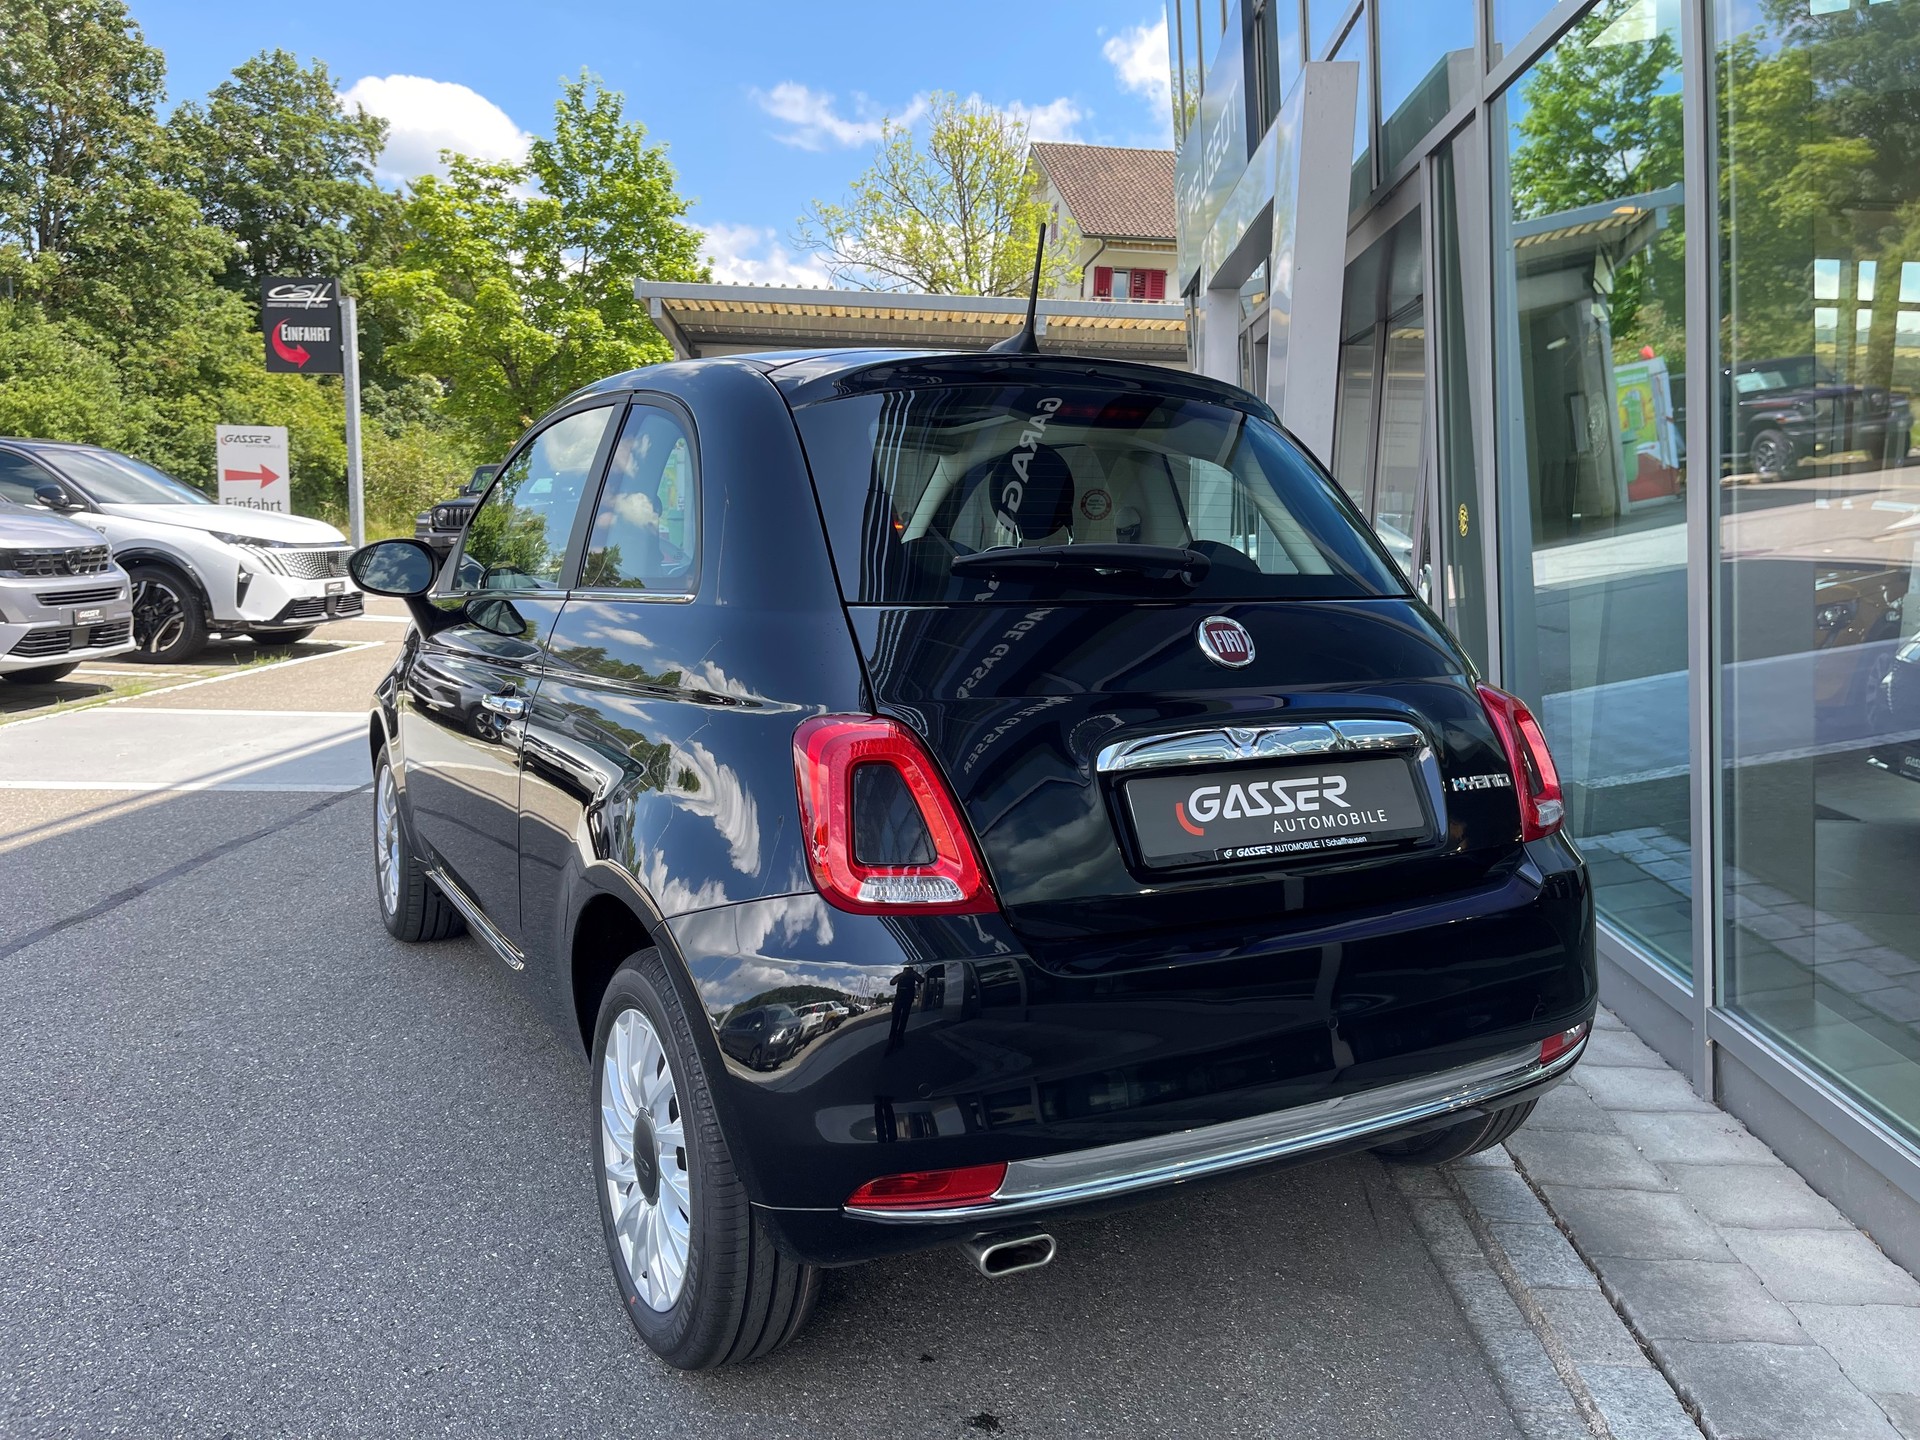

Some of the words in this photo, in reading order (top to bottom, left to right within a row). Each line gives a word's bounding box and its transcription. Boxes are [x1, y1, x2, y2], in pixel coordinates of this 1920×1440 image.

[1187, 79, 1238, 226] PEUGEOT
[281, 323, 331, 342] EINFAHRT
[224, 434, 272, 444] GASSER
[1210, 630, 1246, 653] FIAT
[1451, 773, 1512, 791] HYBRID
[1188, 775, 1351, 822] GASSER
[1273, 809, 1388, 834] AUTOMOBILE
[1236, 846, 1273, 858] GASSER
[1274, 840, 1320, 853] AUTOMOBILE
[1326, 836, 1368, 847] Schaffhausen
